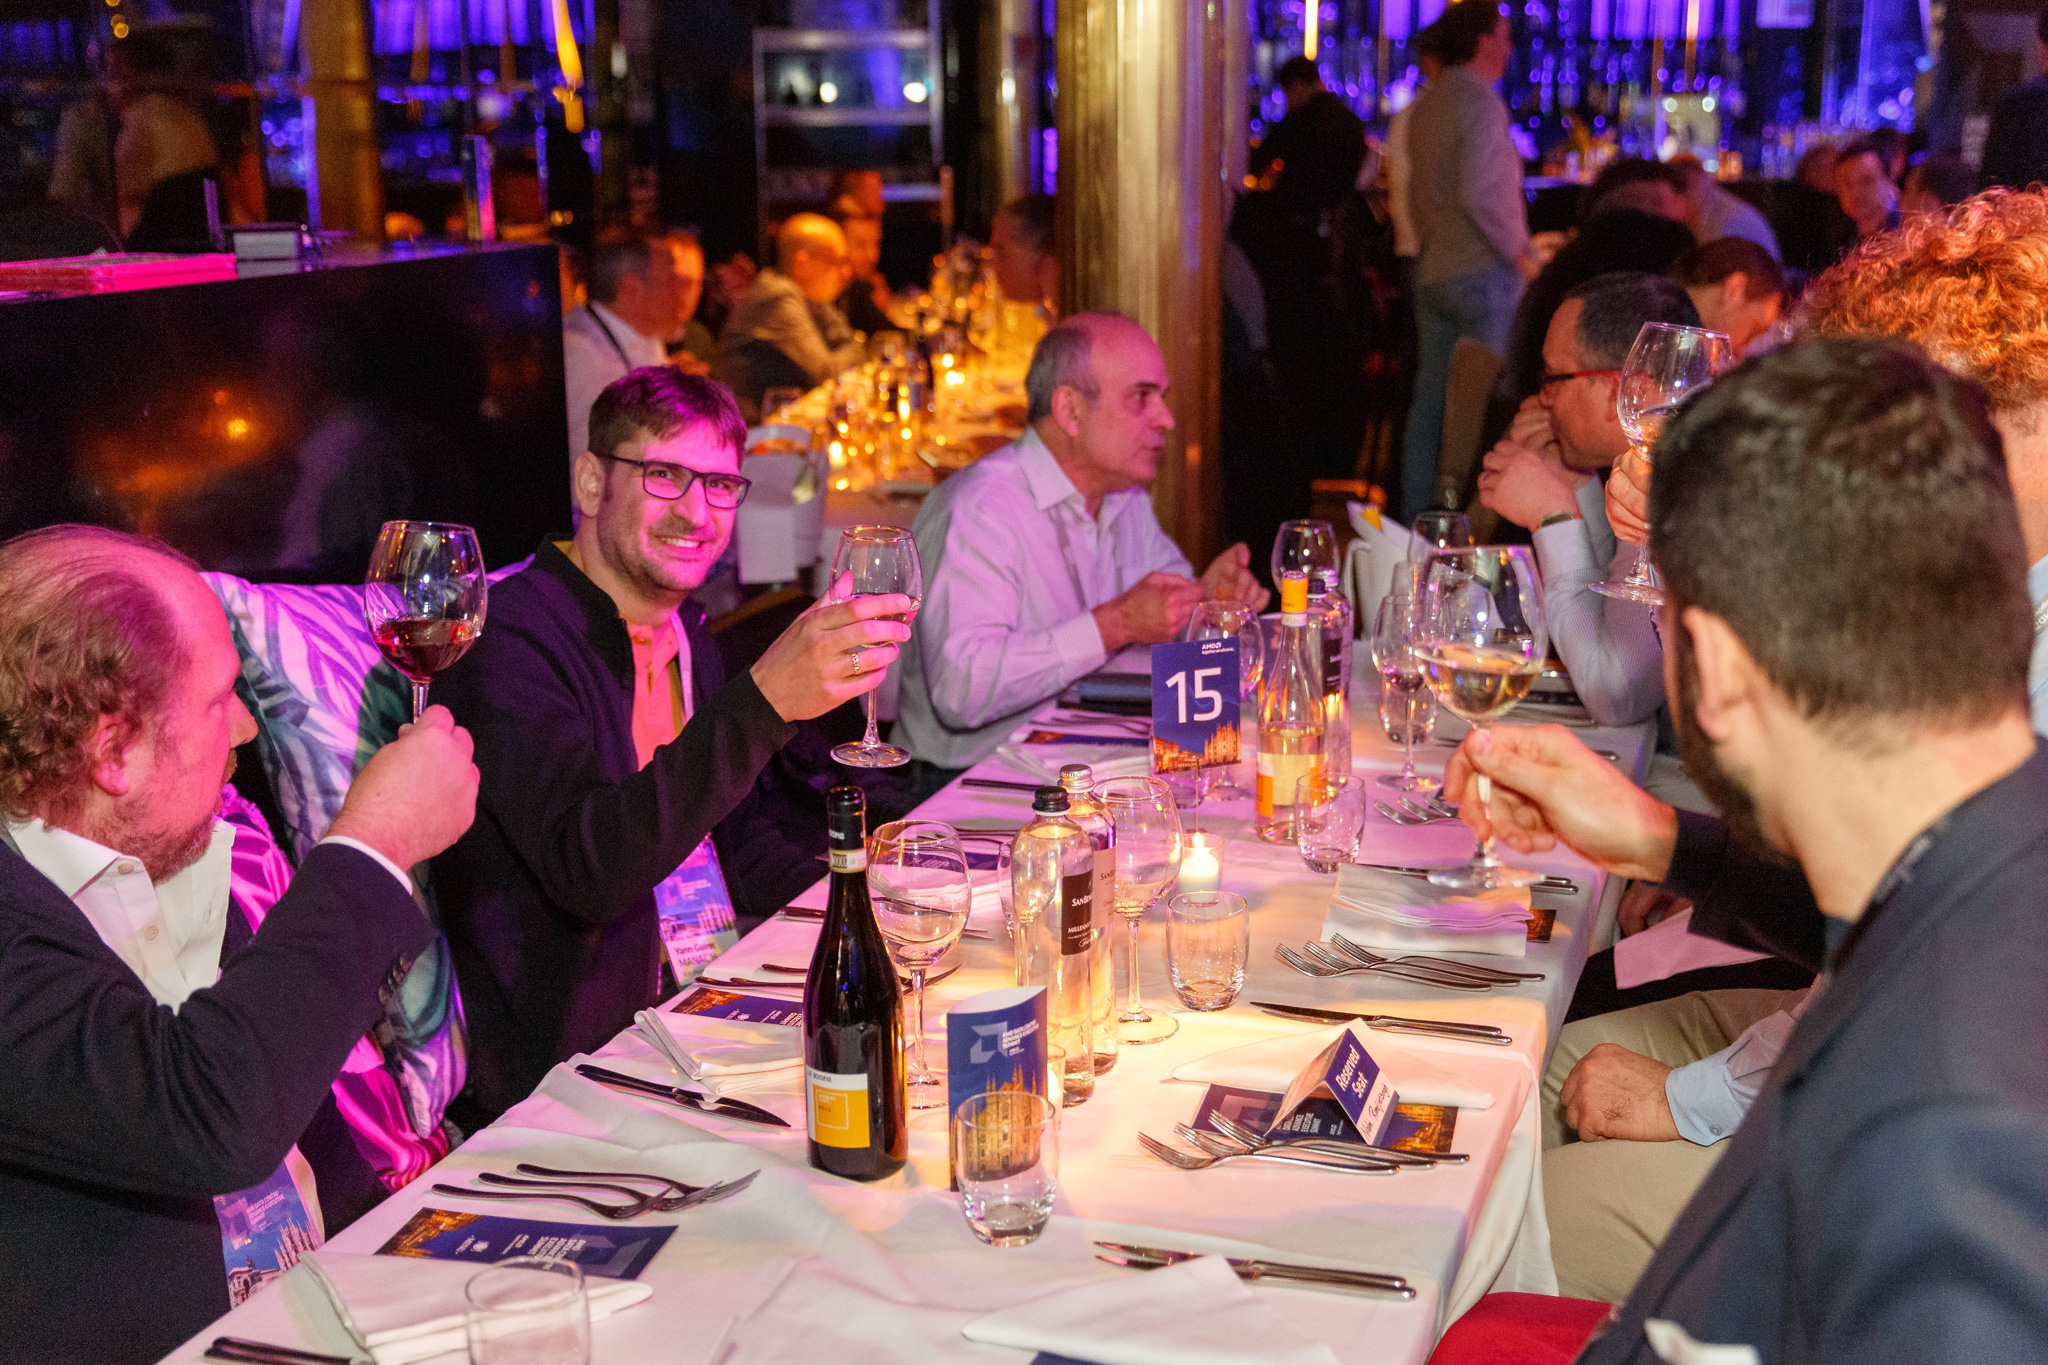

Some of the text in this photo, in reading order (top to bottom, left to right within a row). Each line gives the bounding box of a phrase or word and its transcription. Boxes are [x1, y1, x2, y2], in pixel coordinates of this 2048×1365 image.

[1202, 642, 1216, 650] AMD
[1165, 667, 1223, 724] 15
[1335, 1044, 1360, 1092] Reserved
[1351, 1071, 1368, 1099] Seat
